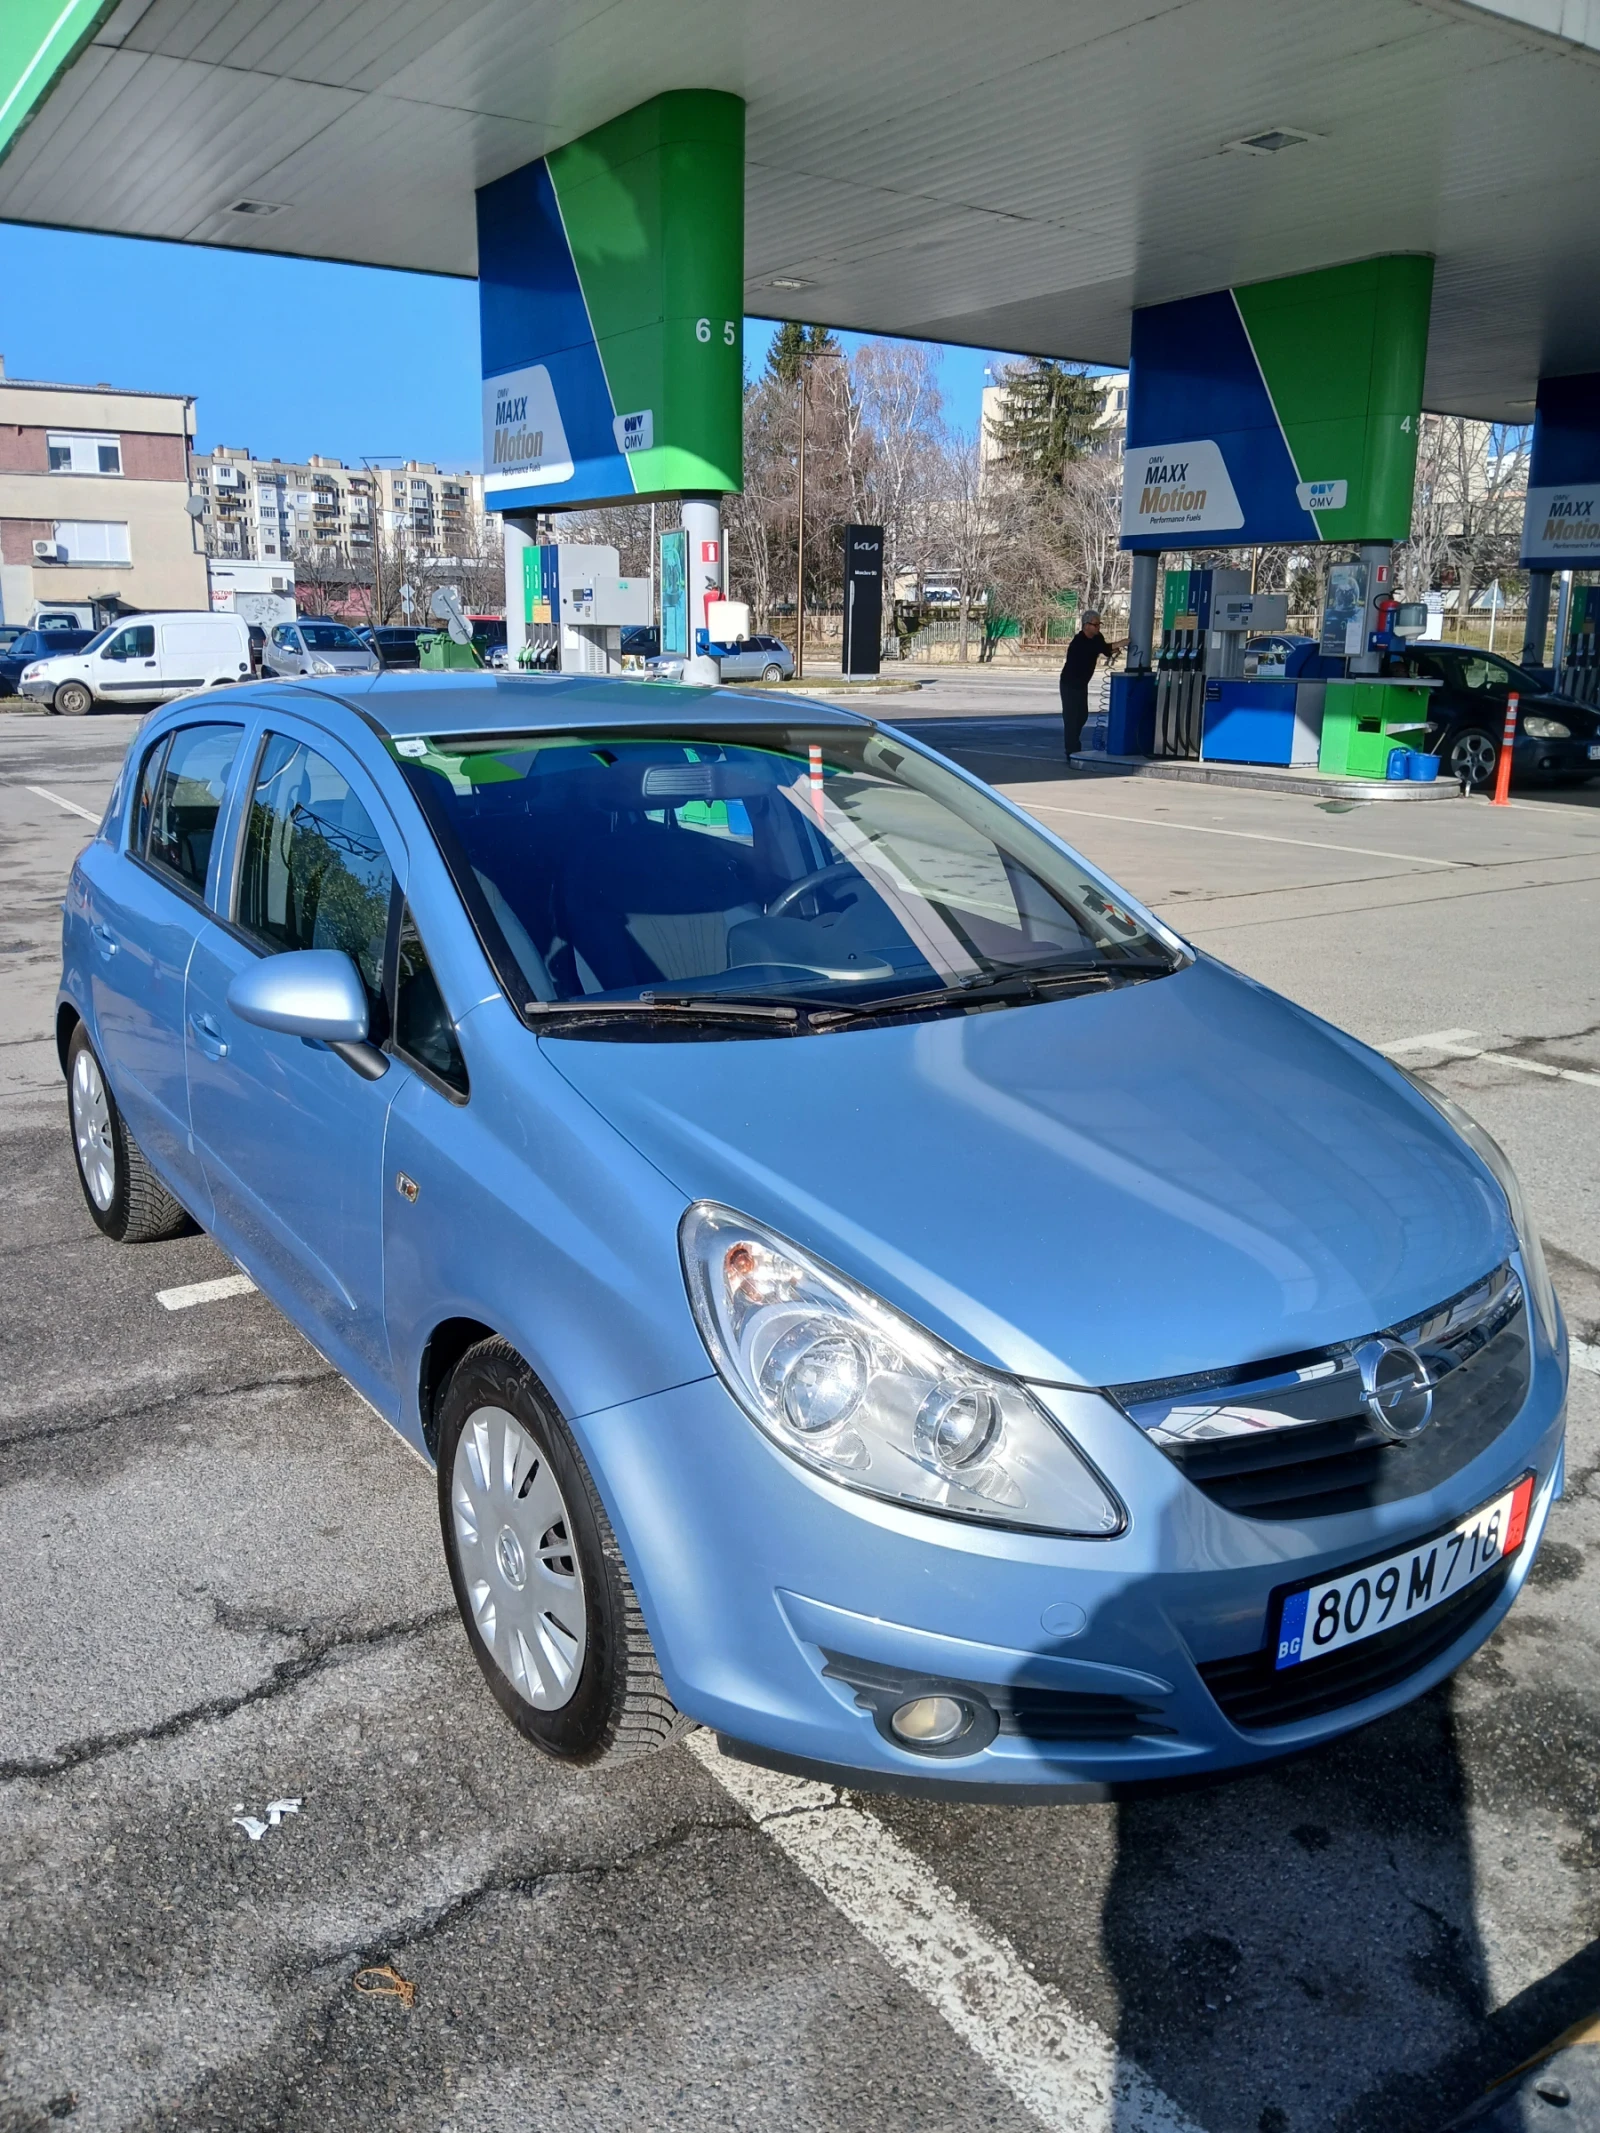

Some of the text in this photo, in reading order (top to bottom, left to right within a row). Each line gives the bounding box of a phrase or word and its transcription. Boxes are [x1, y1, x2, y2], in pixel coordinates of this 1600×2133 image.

[696, 318, 735, 346] 6 5
[495, 396, 528, 426] MAXX
[1400, 415, 1411, 434] 4
[493, 424, 543, 464] Motion
[624, 433, 643, 450] OMV
[502, 462, 541, 477] Performance Fuels
[1149, 456, 1164, 465] OMV
[1145, 463, 1189, 485] MAXX
[1139, 484, 1207, 515] Motion
[1309, 497, 1333, 508] OMV
[1549, 501, 1594, 517] MAXX
[1149, 514, 1202, 525] Performance Fuels
[1542, 518, 1600, 541] Motio
[854, 541, 879, 551] KIA
[1312, 1509, 1501, 1647] 809M718
[1278, 1637, 1301, 1660] BG
